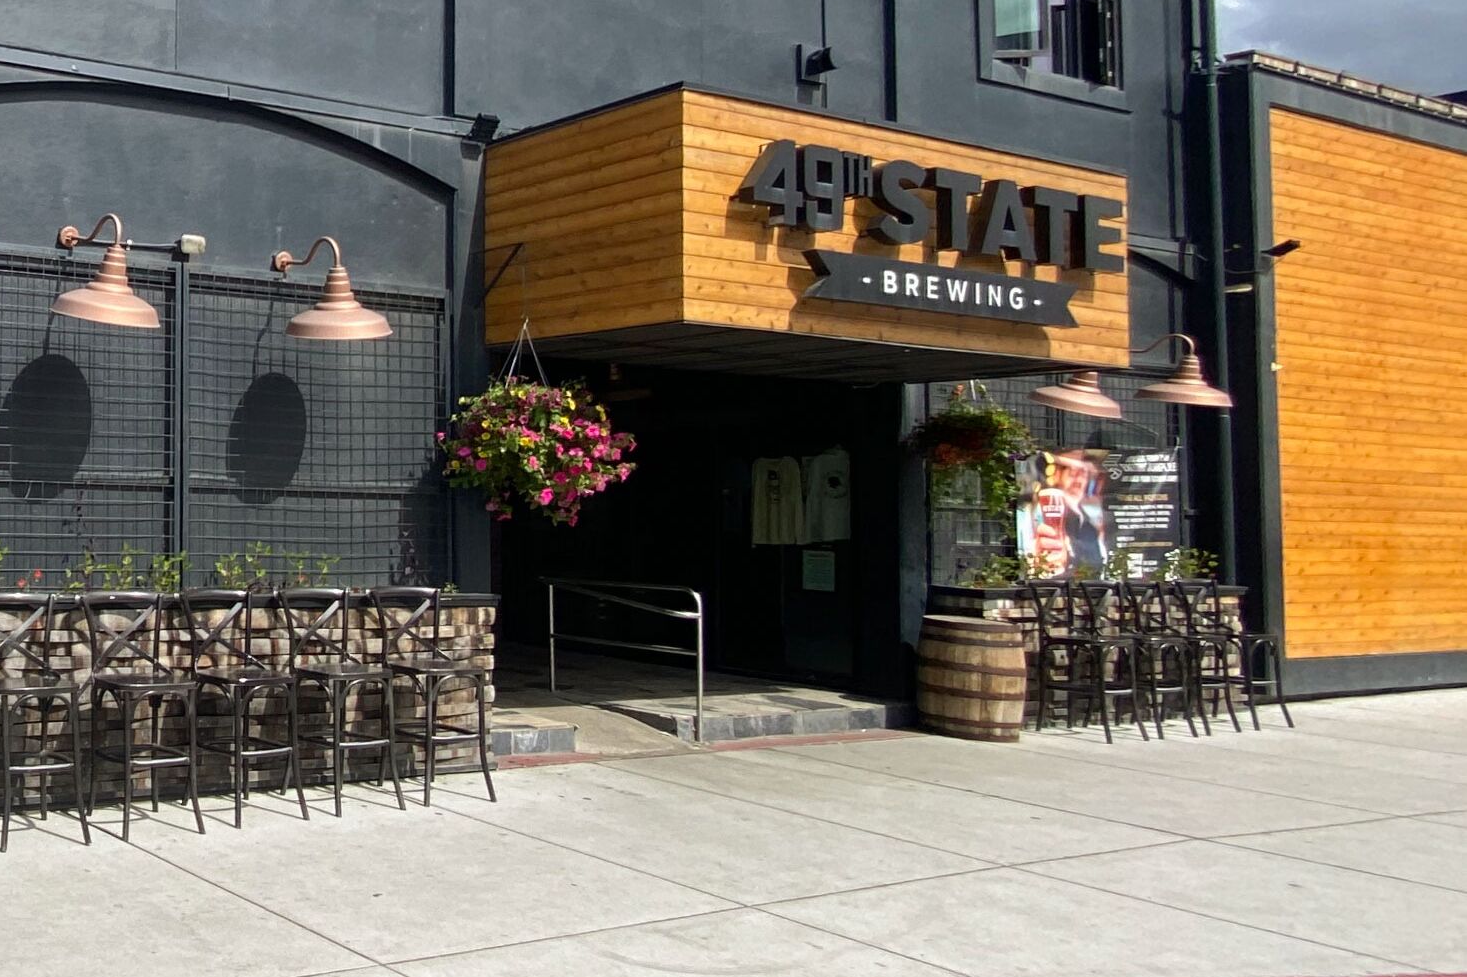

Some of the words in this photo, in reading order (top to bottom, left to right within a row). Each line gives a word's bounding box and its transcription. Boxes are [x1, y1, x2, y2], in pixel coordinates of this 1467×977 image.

[746, 139, 873, 231] 49TH
[879, 160, 1125, 273] STATE
[882, 269, 1026, 311] BREWING
